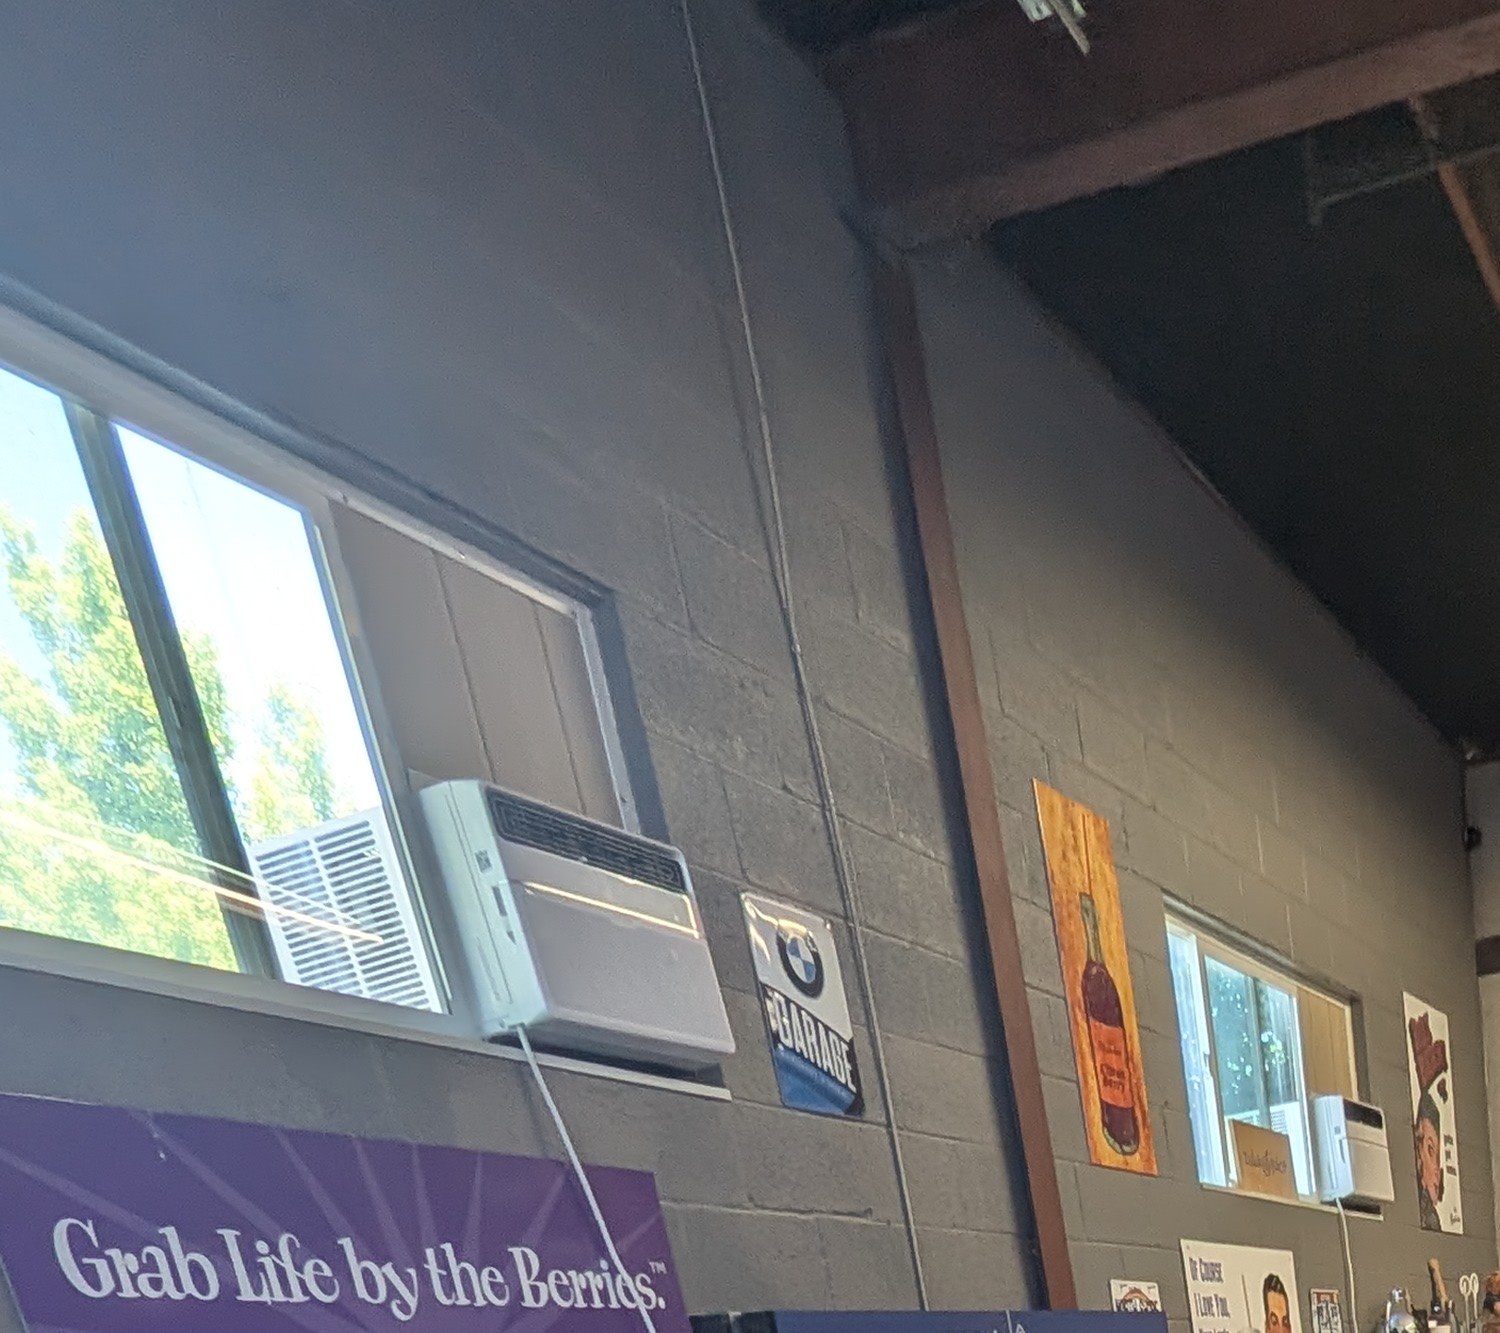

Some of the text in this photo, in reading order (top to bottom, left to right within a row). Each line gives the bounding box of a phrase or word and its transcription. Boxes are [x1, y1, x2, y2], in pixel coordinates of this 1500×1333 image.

[773, 990, 858, 1094] GARAGE
[53, 1217, 220, 1301] Grab
[216, 1228, 340, 1304] Life
[337, 1237, 418, 1321] by
[424, 1243, 510, 1308] the
[1199, 1258, 1224, 1283] COURSE
[1201, 1294, 1215, 1318] LOVE
